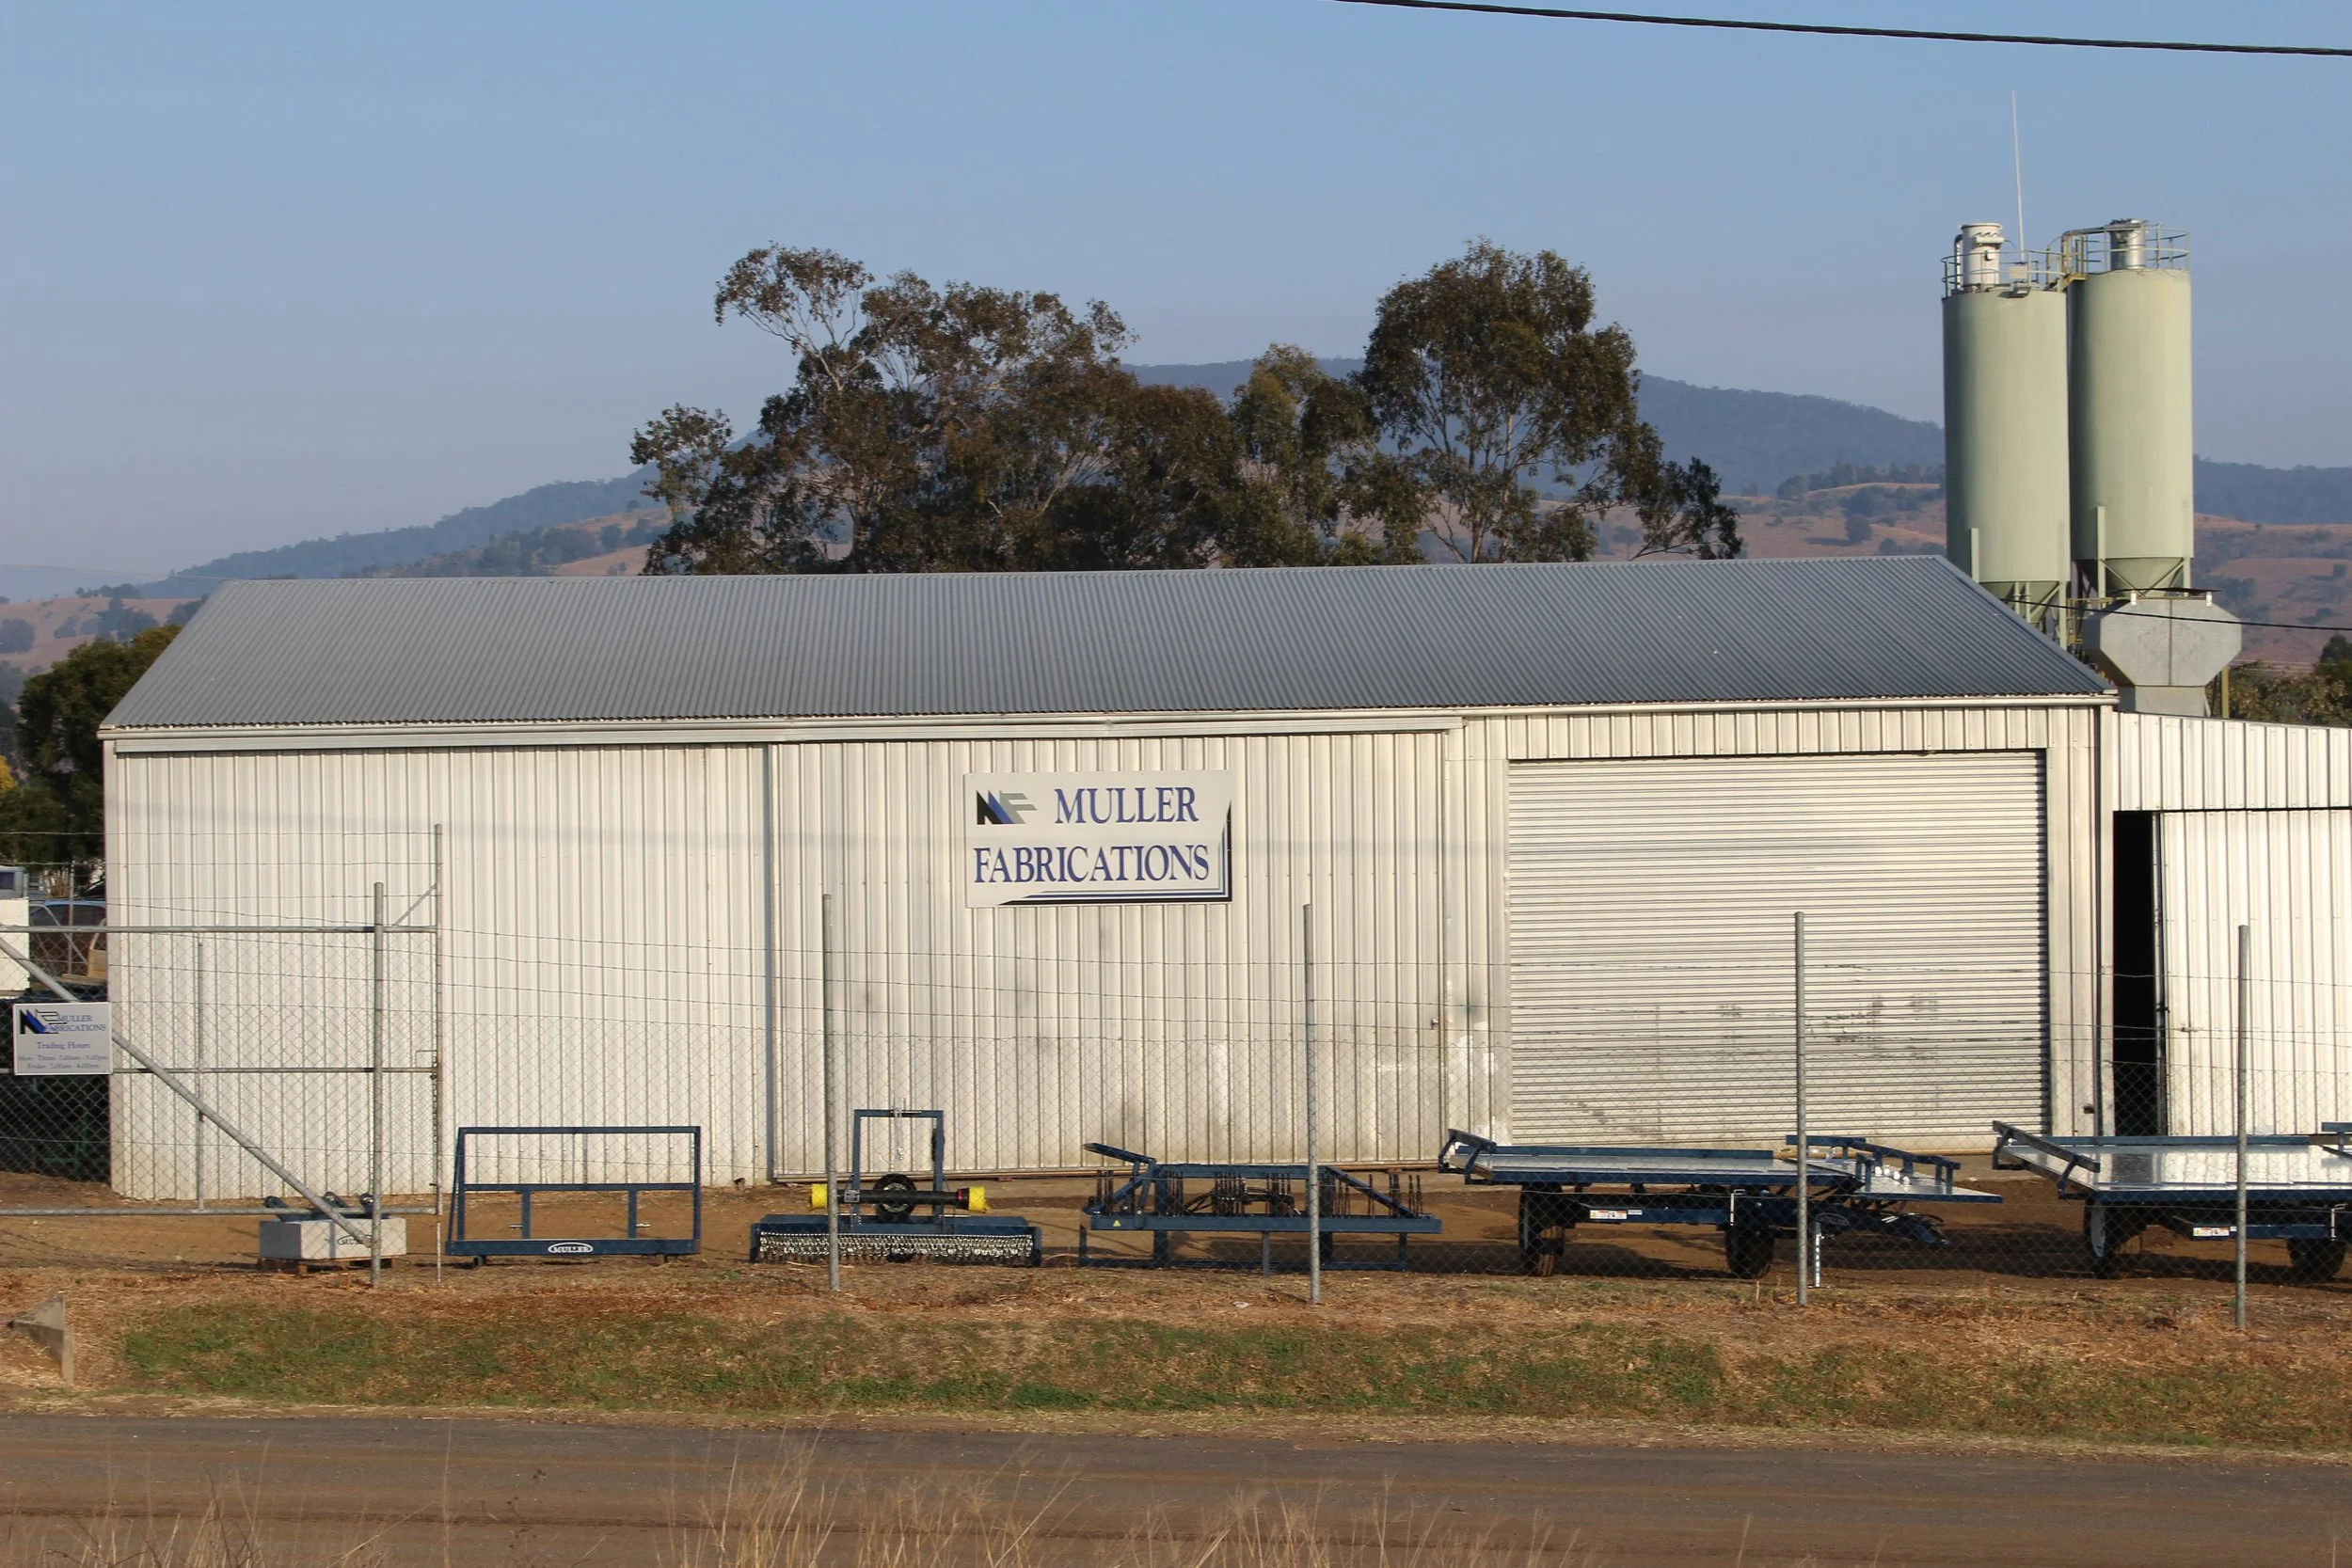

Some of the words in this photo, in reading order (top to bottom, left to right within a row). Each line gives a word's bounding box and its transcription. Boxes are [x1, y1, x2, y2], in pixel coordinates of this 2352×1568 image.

[1054, 786, 1199, 825] MULLER
[973, 844, 1210, 883] FABRICATIONS
[45, 1023, 106, 1032] FABRICATIONS
[36, 1041, 66, 1050] Trading
[68, 1041, 91, 1050] Hours
